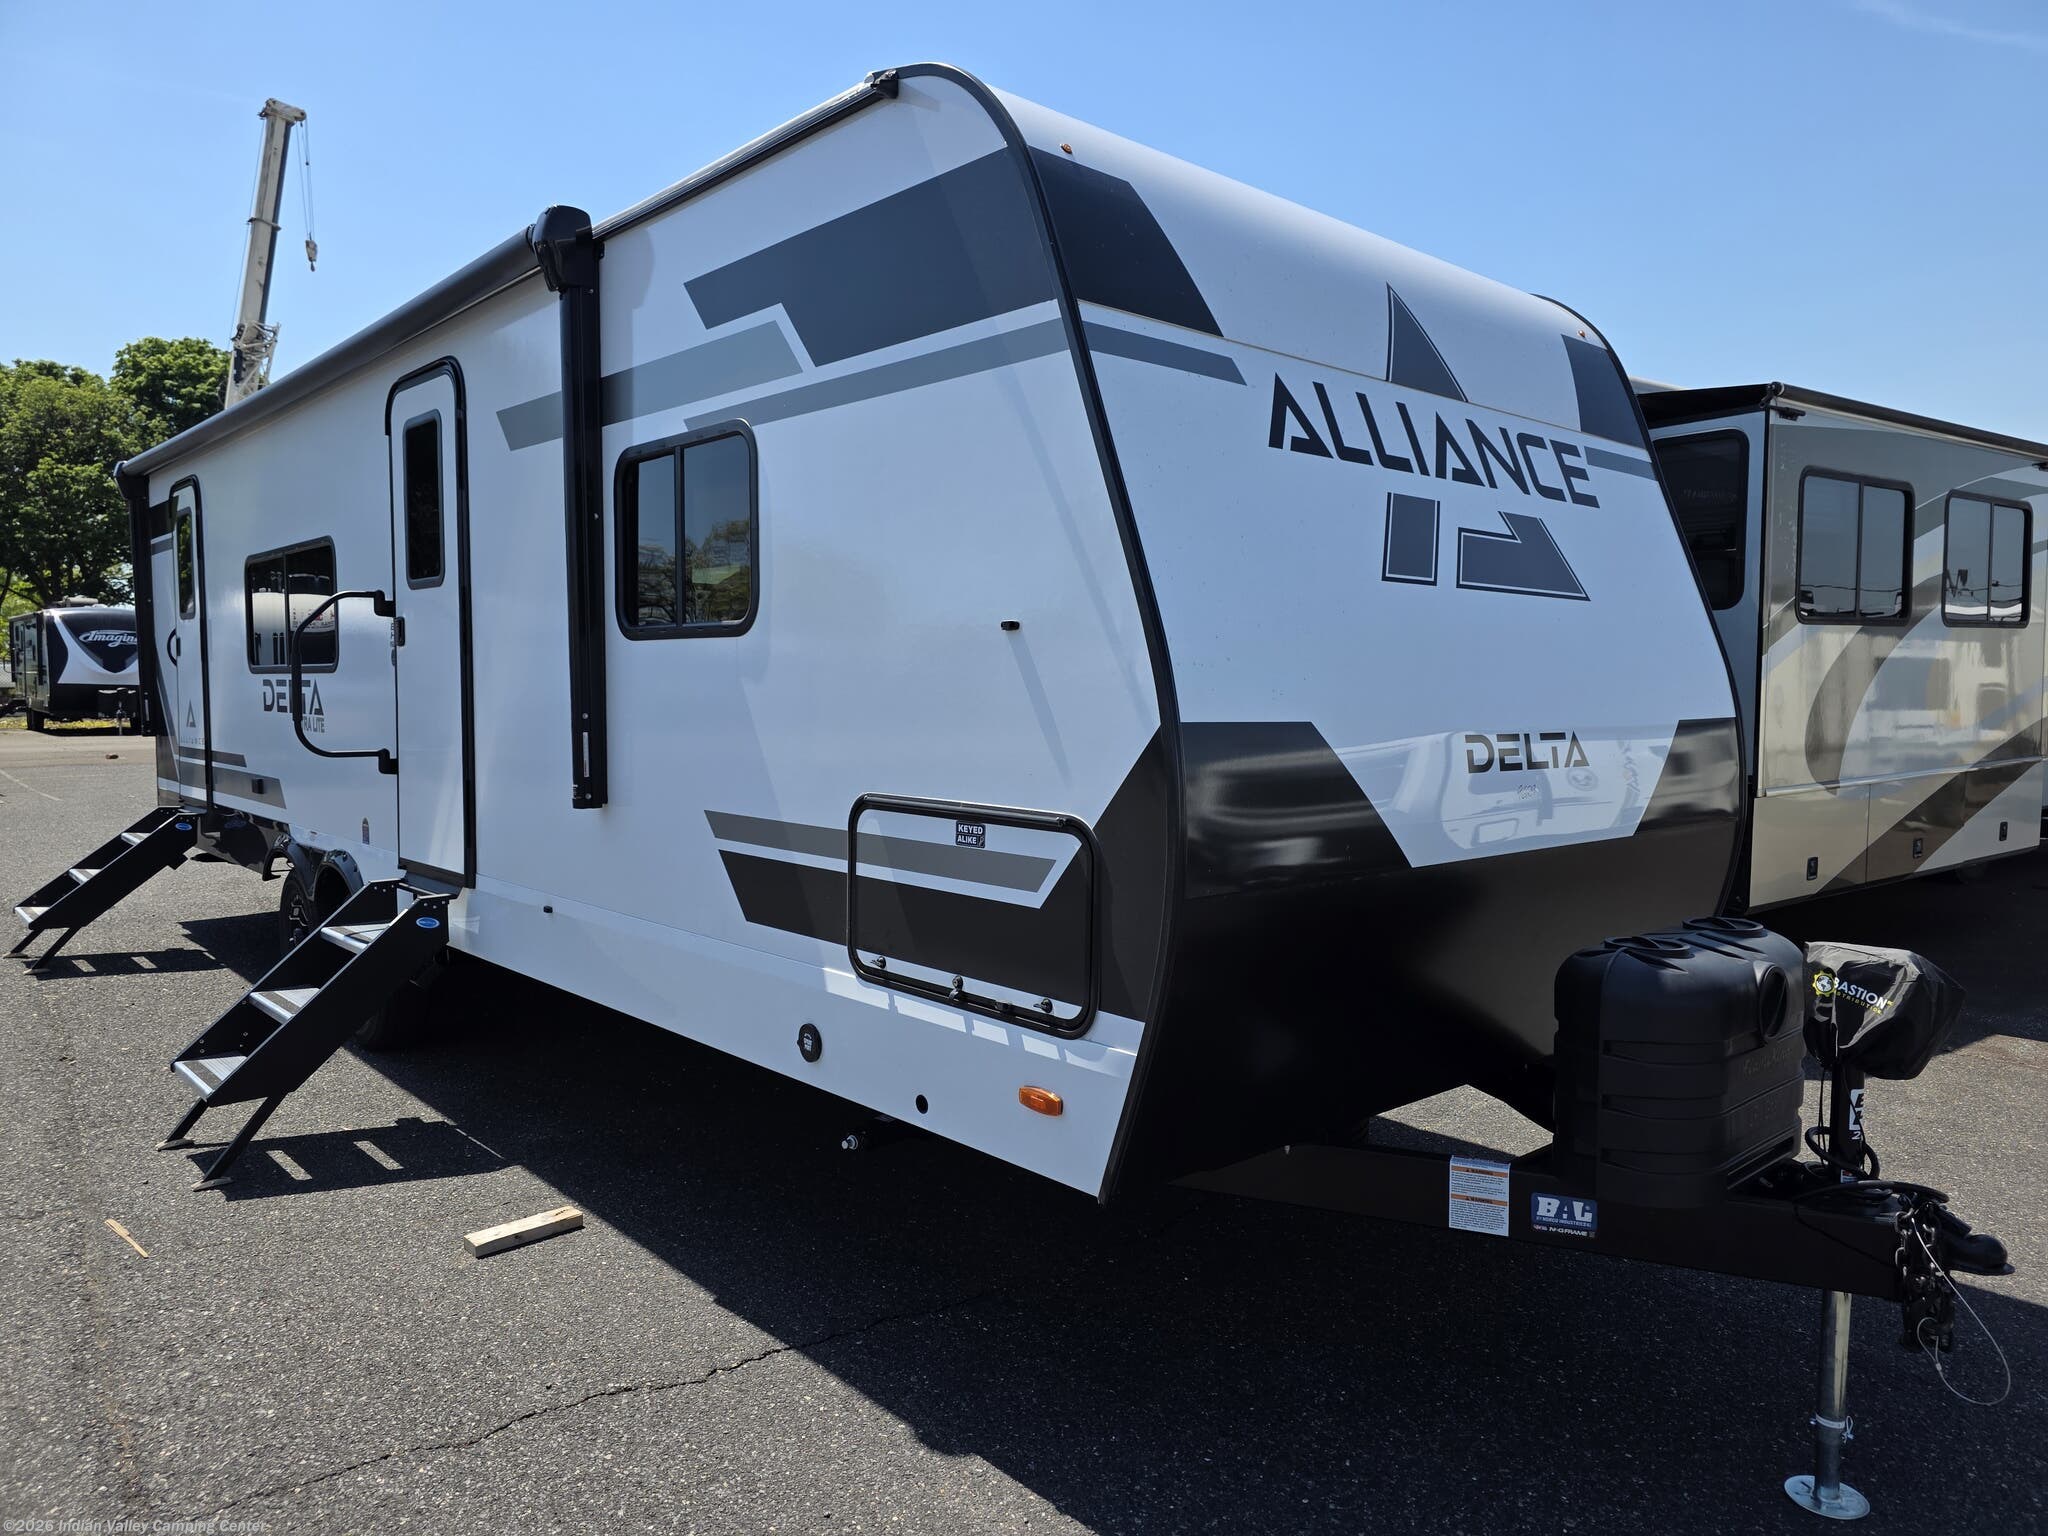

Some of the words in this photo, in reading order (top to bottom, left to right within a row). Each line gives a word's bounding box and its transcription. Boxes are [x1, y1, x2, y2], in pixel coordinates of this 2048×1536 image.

[1268, 371, 1600, 509] ALLIANCE
[79, 630, 137, 647] Imagin
[1465, 730, 1590, 774] DELTA
[958, 824, 984, 835] KEYED
[957, 834, 977, 845] ALIKE
